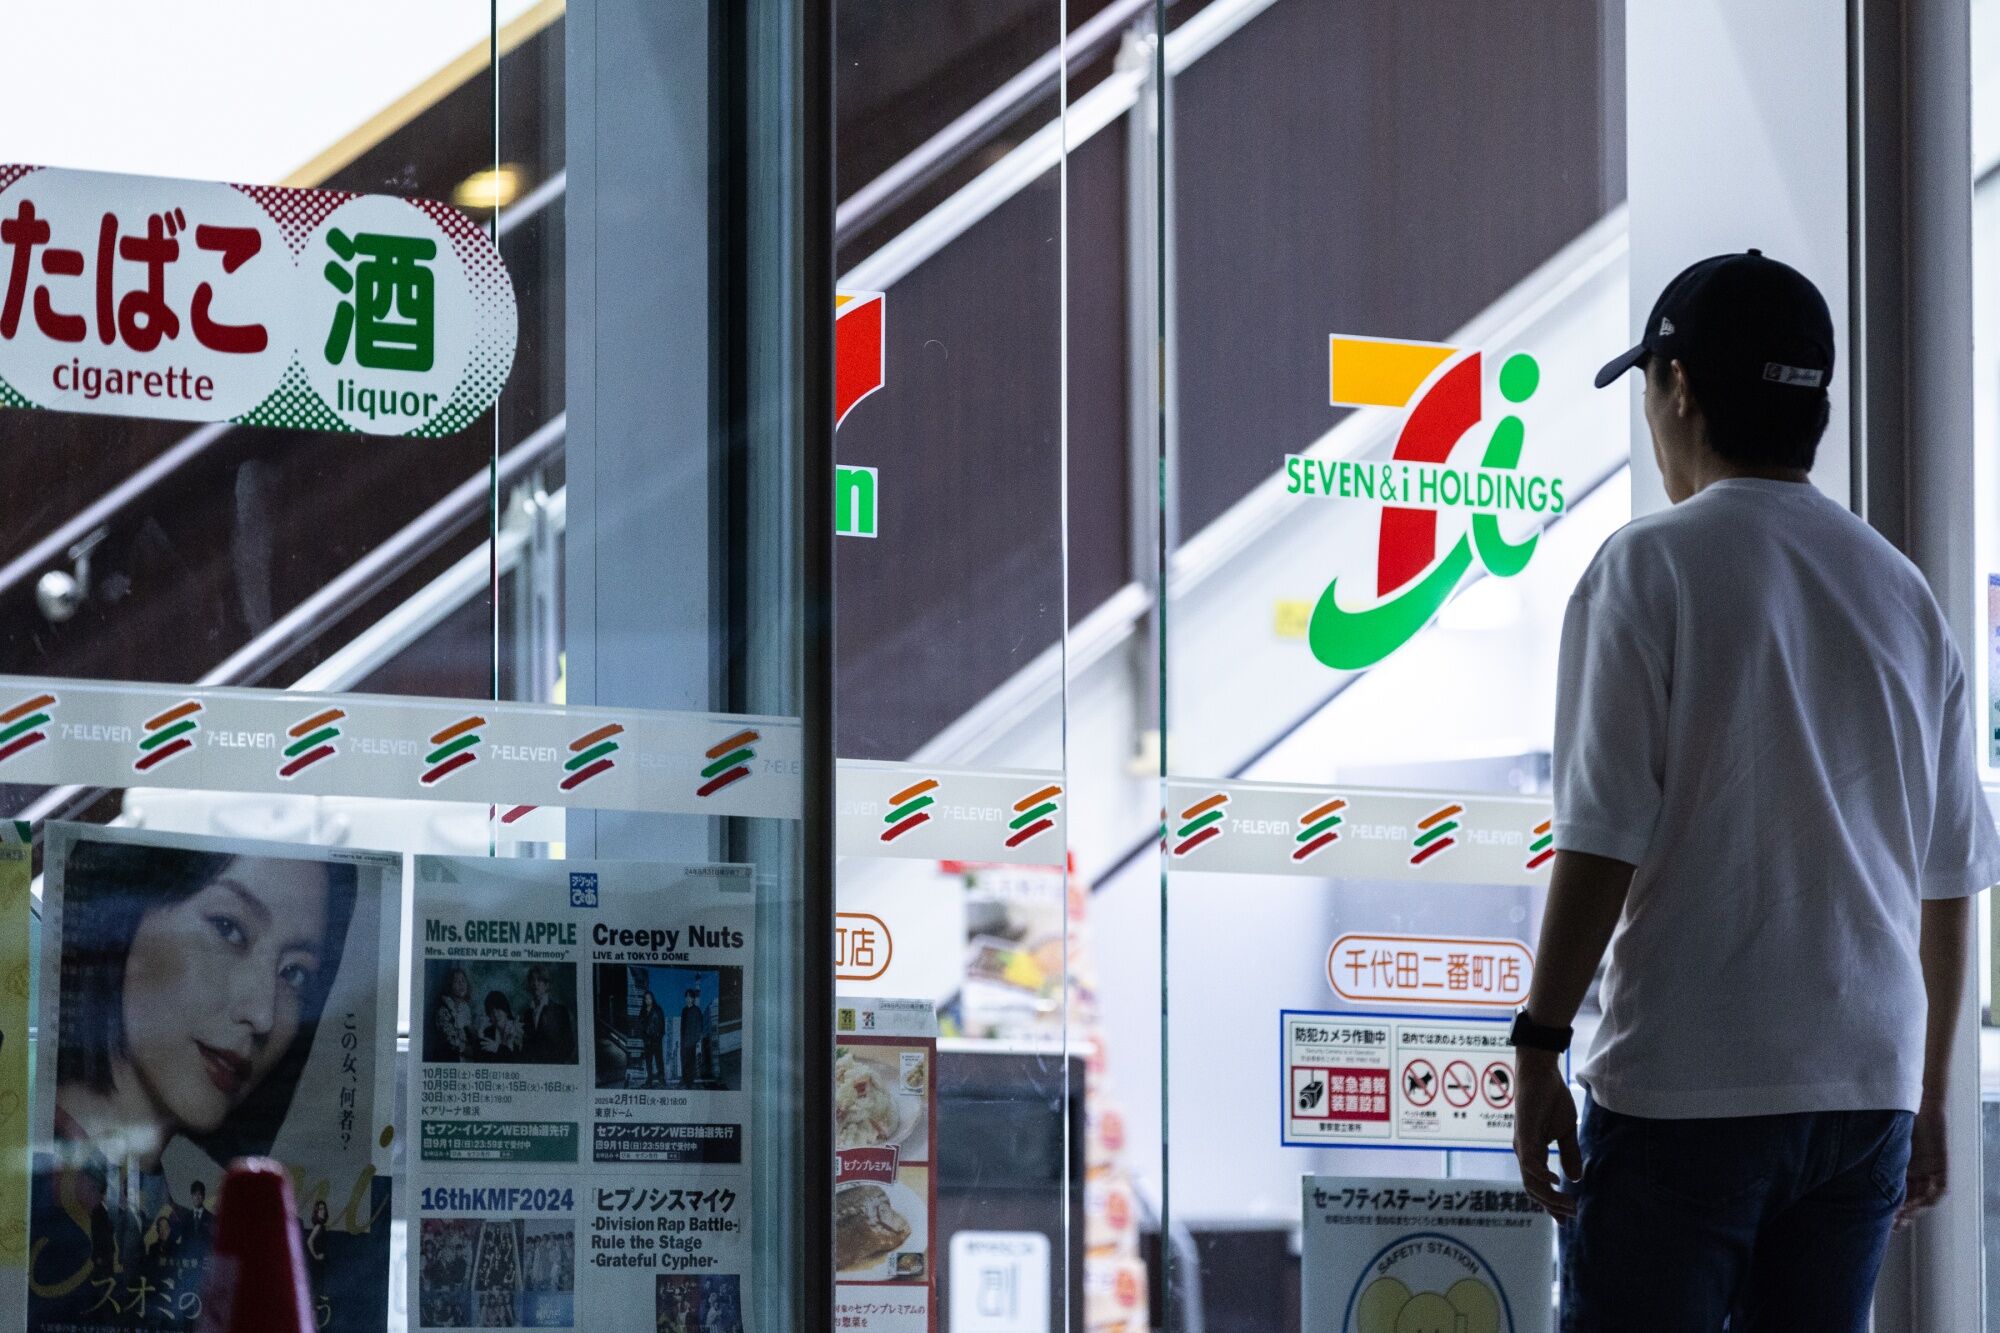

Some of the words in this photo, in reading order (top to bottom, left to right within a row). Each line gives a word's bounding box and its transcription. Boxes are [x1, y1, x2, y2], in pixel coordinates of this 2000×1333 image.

[0, 199, 268, 354] たばこ
[324, 227, 437, 373] 酒
[52, 358, 214, 402] cigarette
[337, 379, 438, 420] liquor
[1419, 468, 1564, 513] HOLDINGS
[425, 919, 461, 942] Mrs.
[464, 920, 520, 943] GREEN
[524, 922, 577, 945] APPLE
[593, 923, 680, 952] Creepy
[688, 925, 744, 948] Nuts
[424, 947, 446, 956] Mrs.
[447, 947, 478, 957] GREEN
[480, 948, 508, 957] APPLE
[510, 950, 521, 958] on
[593, 951, 612, 960] LIVE
[614, 951, 625, 960] at
[627, 952, 659, 961] TOKYO
[661, 952, 689, 961] DOME
[1344, 949, 1520, 993] 千代田二番町店
[1295, 1027, 1386, 1044] 防犯カメラ作動中
[595, 1108, 633, 1118] 東京ドーム
[421, 1187, 575, 1211] 16thKMF2024
[657, 1217, 686, 1233] Rap
[592, 1235, 625, 1249] Rule
[629, 1235, 655, 1249] the
[658, 1235, 702, 1252] Stage
[590, 1252, 657, 1267] -Grateful
[661, 1253, 719, 1270] Cypher-
[1377, 1242, 1423, 1274] SAFETY
[1426, 1241, 1480, 1274] STATION
